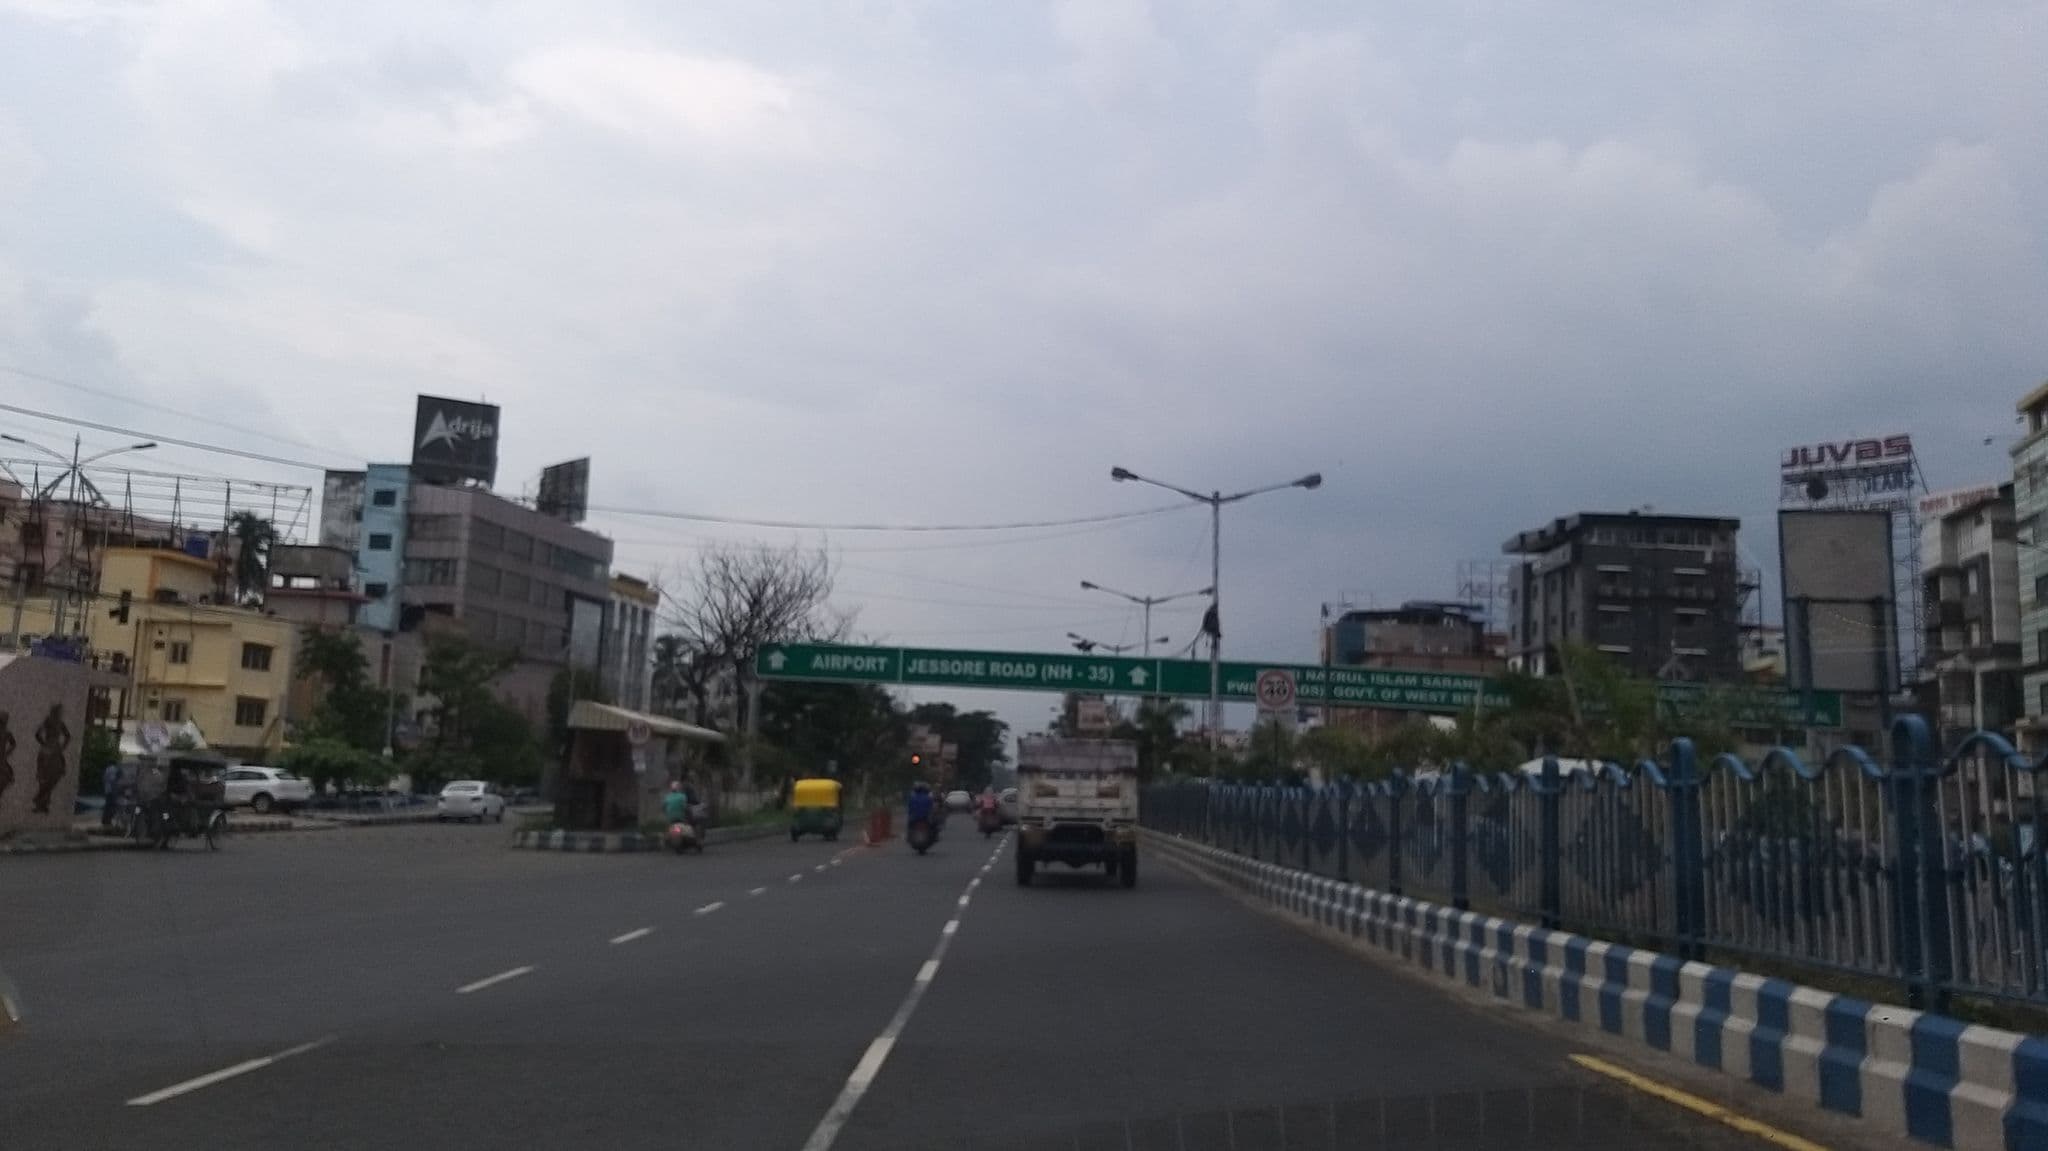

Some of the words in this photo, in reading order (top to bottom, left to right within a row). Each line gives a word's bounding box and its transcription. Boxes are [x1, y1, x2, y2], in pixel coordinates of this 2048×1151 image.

[419, 408, 494, 451] Adrija
[812, 654, 889, 673] AIRPORT
[907, 658, 985, 677] JESSORE
[989, 661, 1037, 679] ROAD
[1041, 662, 1073, 681] (NH
[1087, 664, 1115, 684] 35)
[1370, 672, 1417, 687] ISLAM
[1380, 687, 1401, 701] OF
[1405, 689, 1449, 703] WEST
